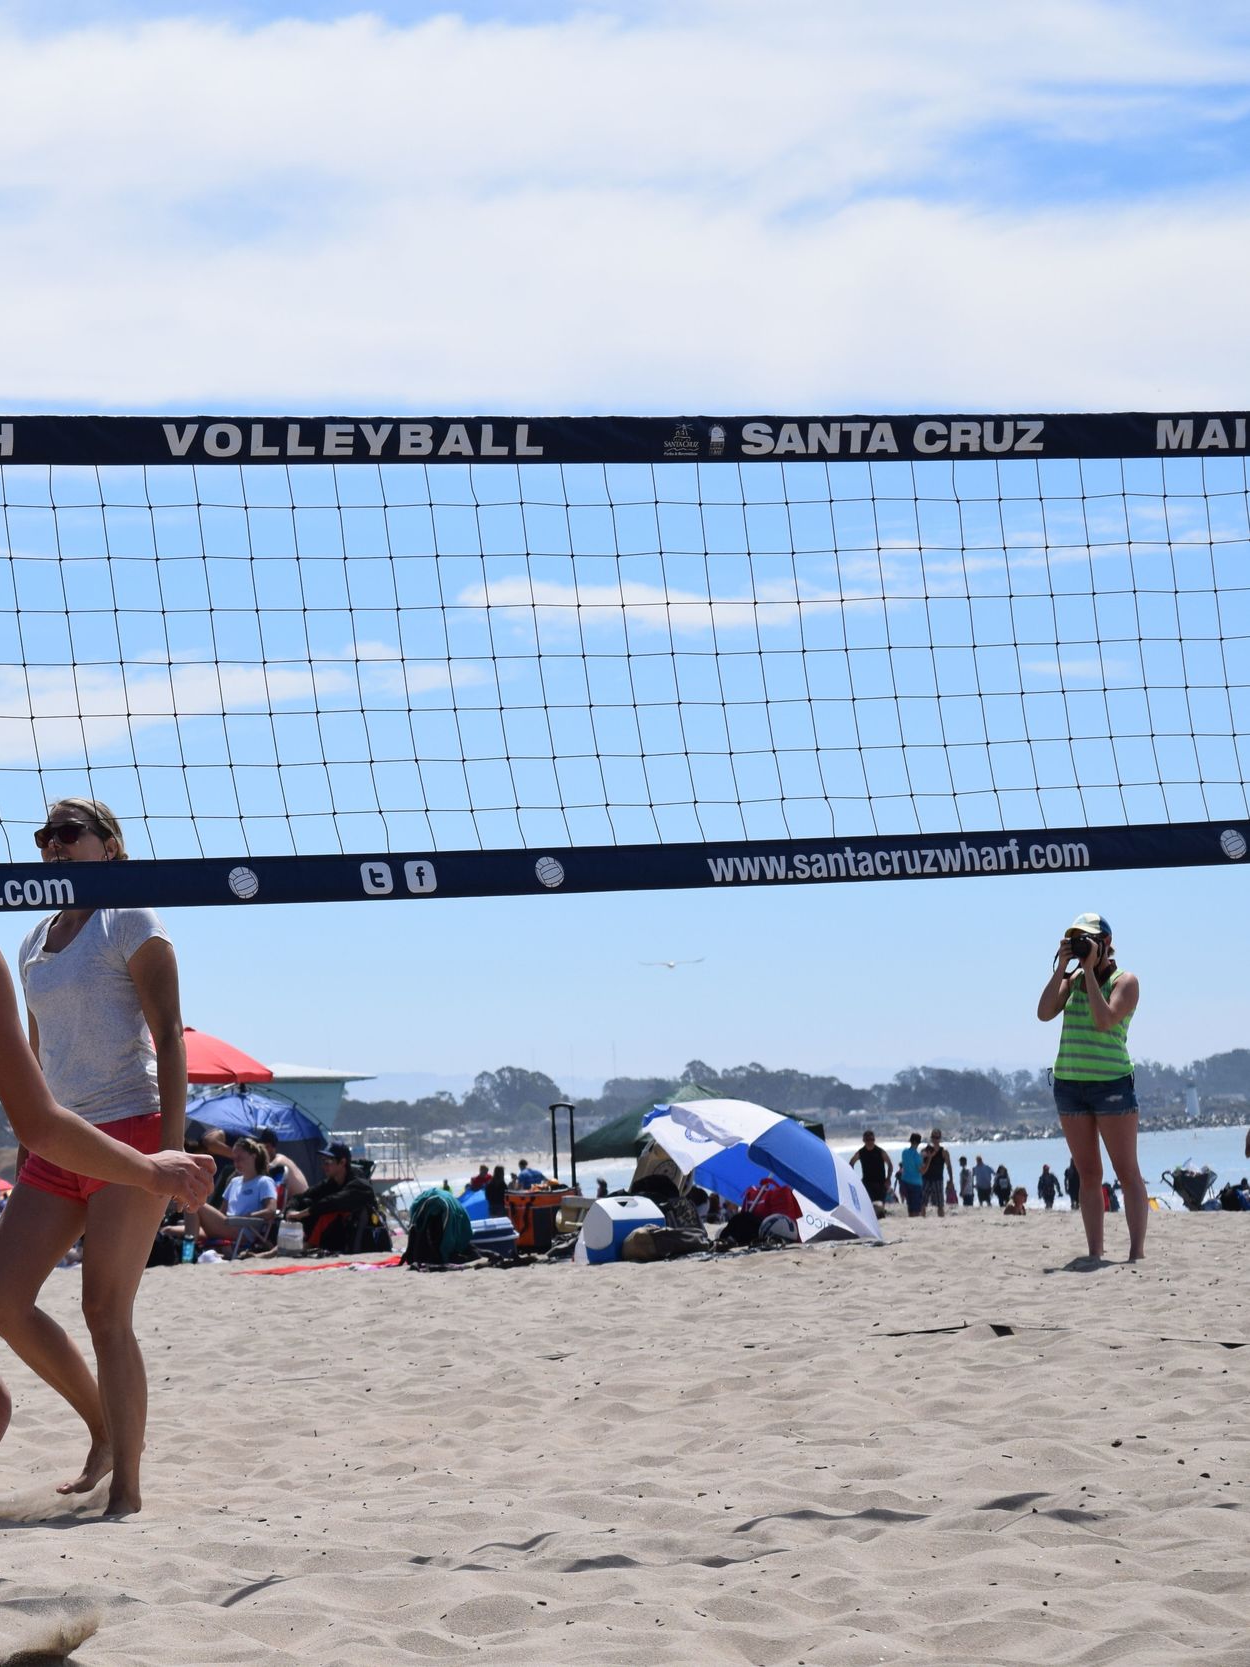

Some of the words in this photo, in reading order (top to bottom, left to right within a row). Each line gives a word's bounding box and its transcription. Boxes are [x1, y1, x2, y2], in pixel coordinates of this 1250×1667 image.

[162, 423, 544, 457] VOLLEYBALL
[741, 421, 898, 455] SANTA
[913, 419, 1044, 453] CRUZ
[1156, 418, 1247, 449] MAI
[706, 839, 1090, 882] www.santacruzwharf.com
